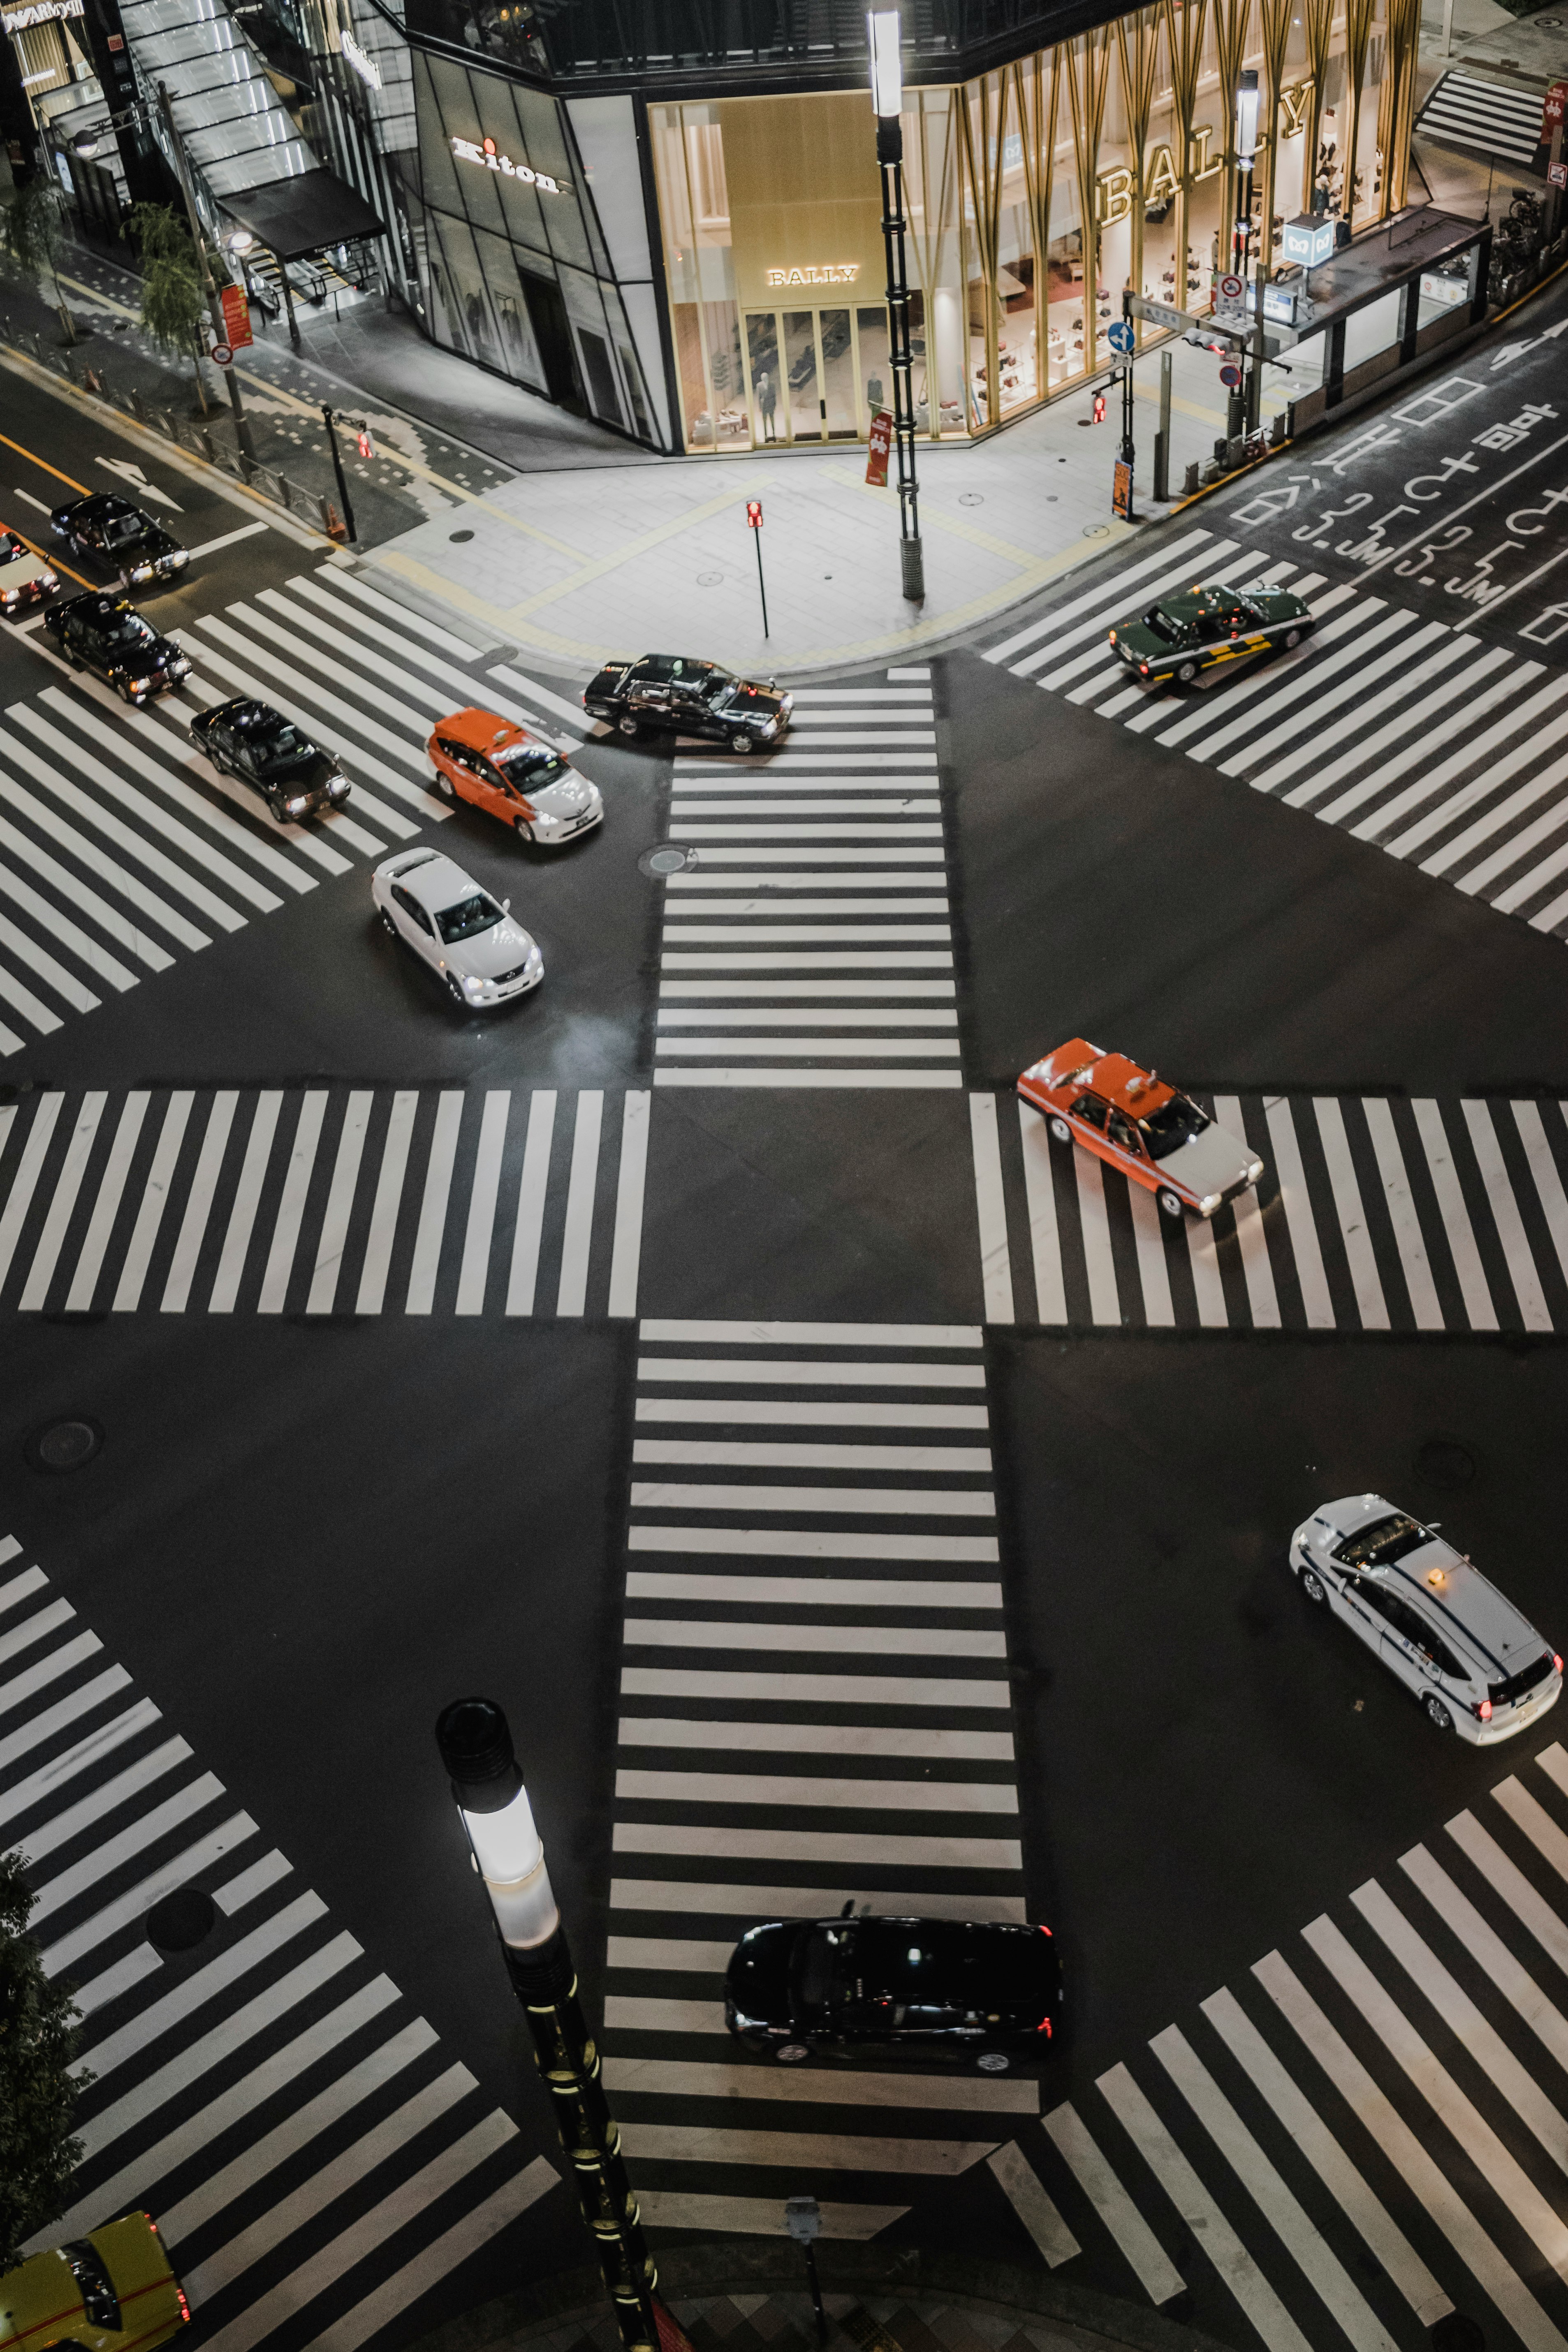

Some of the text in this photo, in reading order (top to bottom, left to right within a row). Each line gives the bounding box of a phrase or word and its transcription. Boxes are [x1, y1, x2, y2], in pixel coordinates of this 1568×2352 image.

[451, 137, 560, 194] Kiton
[1097, 79, 1315, 228] BALY
[768, 266, 858, 286] BALLY
[1230, 376, 1487, 526] 日比谷
